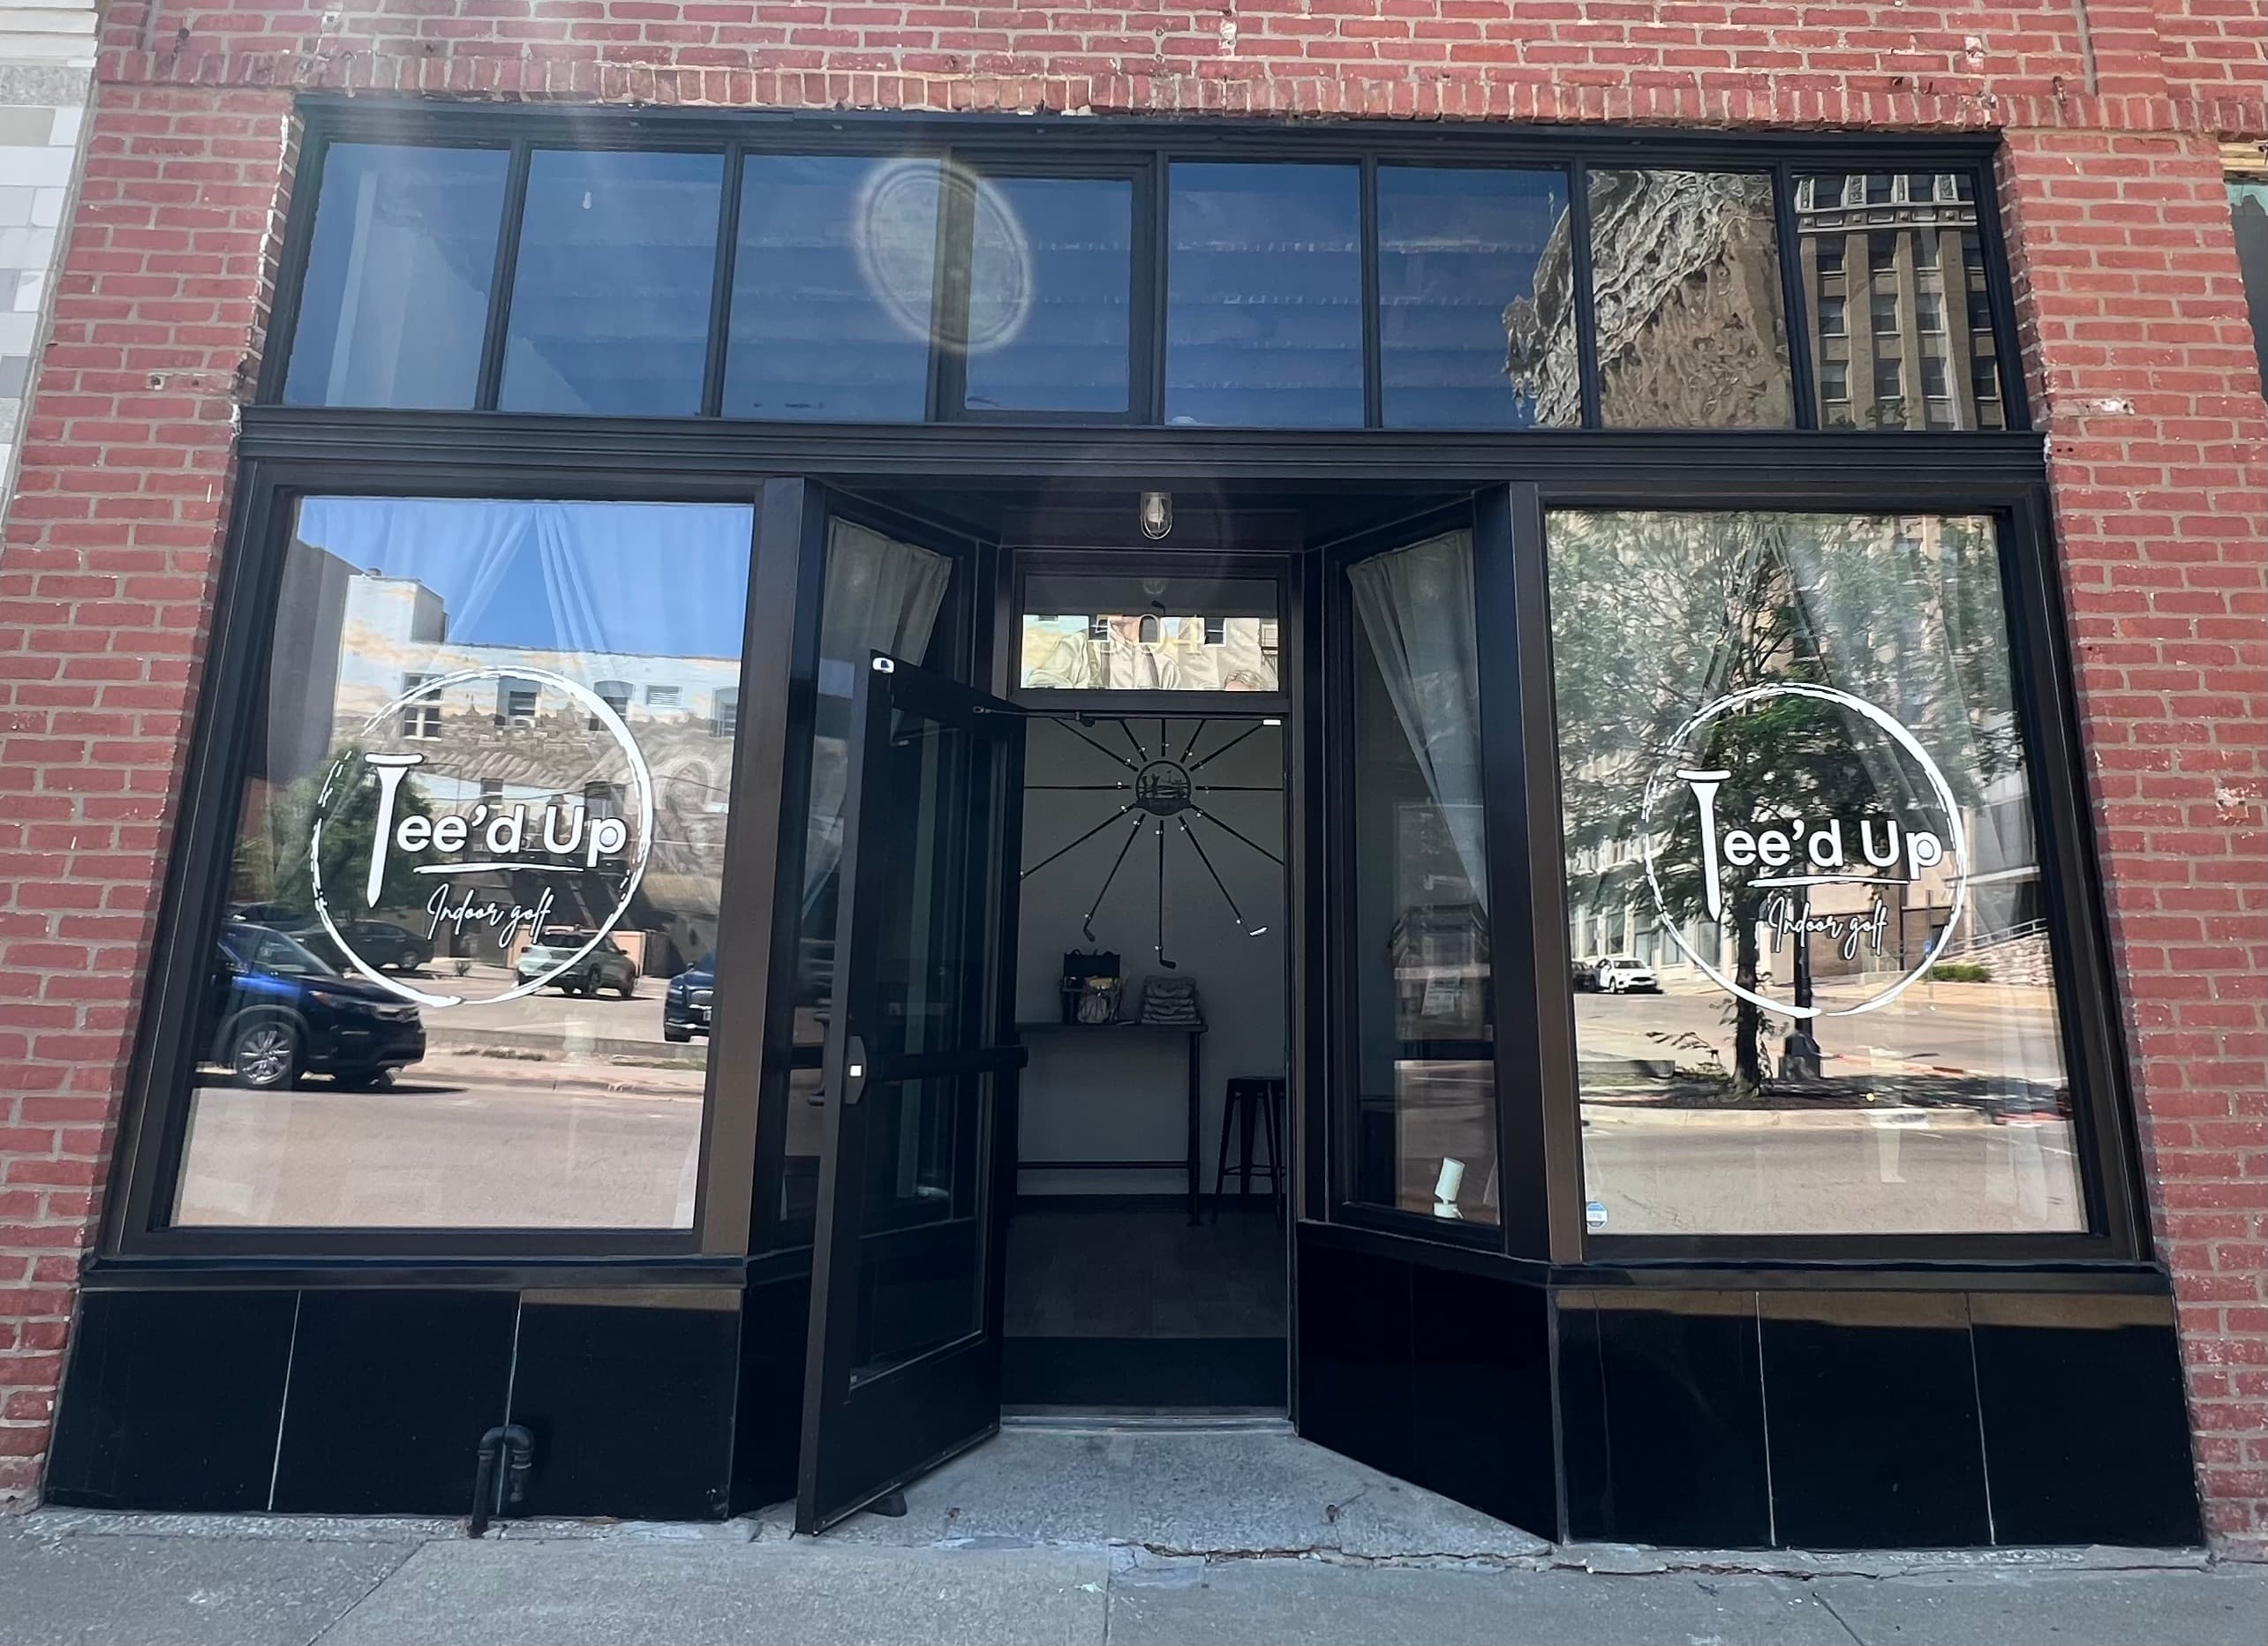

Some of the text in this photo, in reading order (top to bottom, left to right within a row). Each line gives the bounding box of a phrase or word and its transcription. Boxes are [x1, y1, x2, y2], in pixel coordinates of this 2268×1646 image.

[364, 752, 628, 908] Tee'd Up
[1676, 769, 1942, 921] Tee'd Up
[426, 883, 554, 948] Indoor golf
[1767, 896, 1887, 960] Indoor golf
